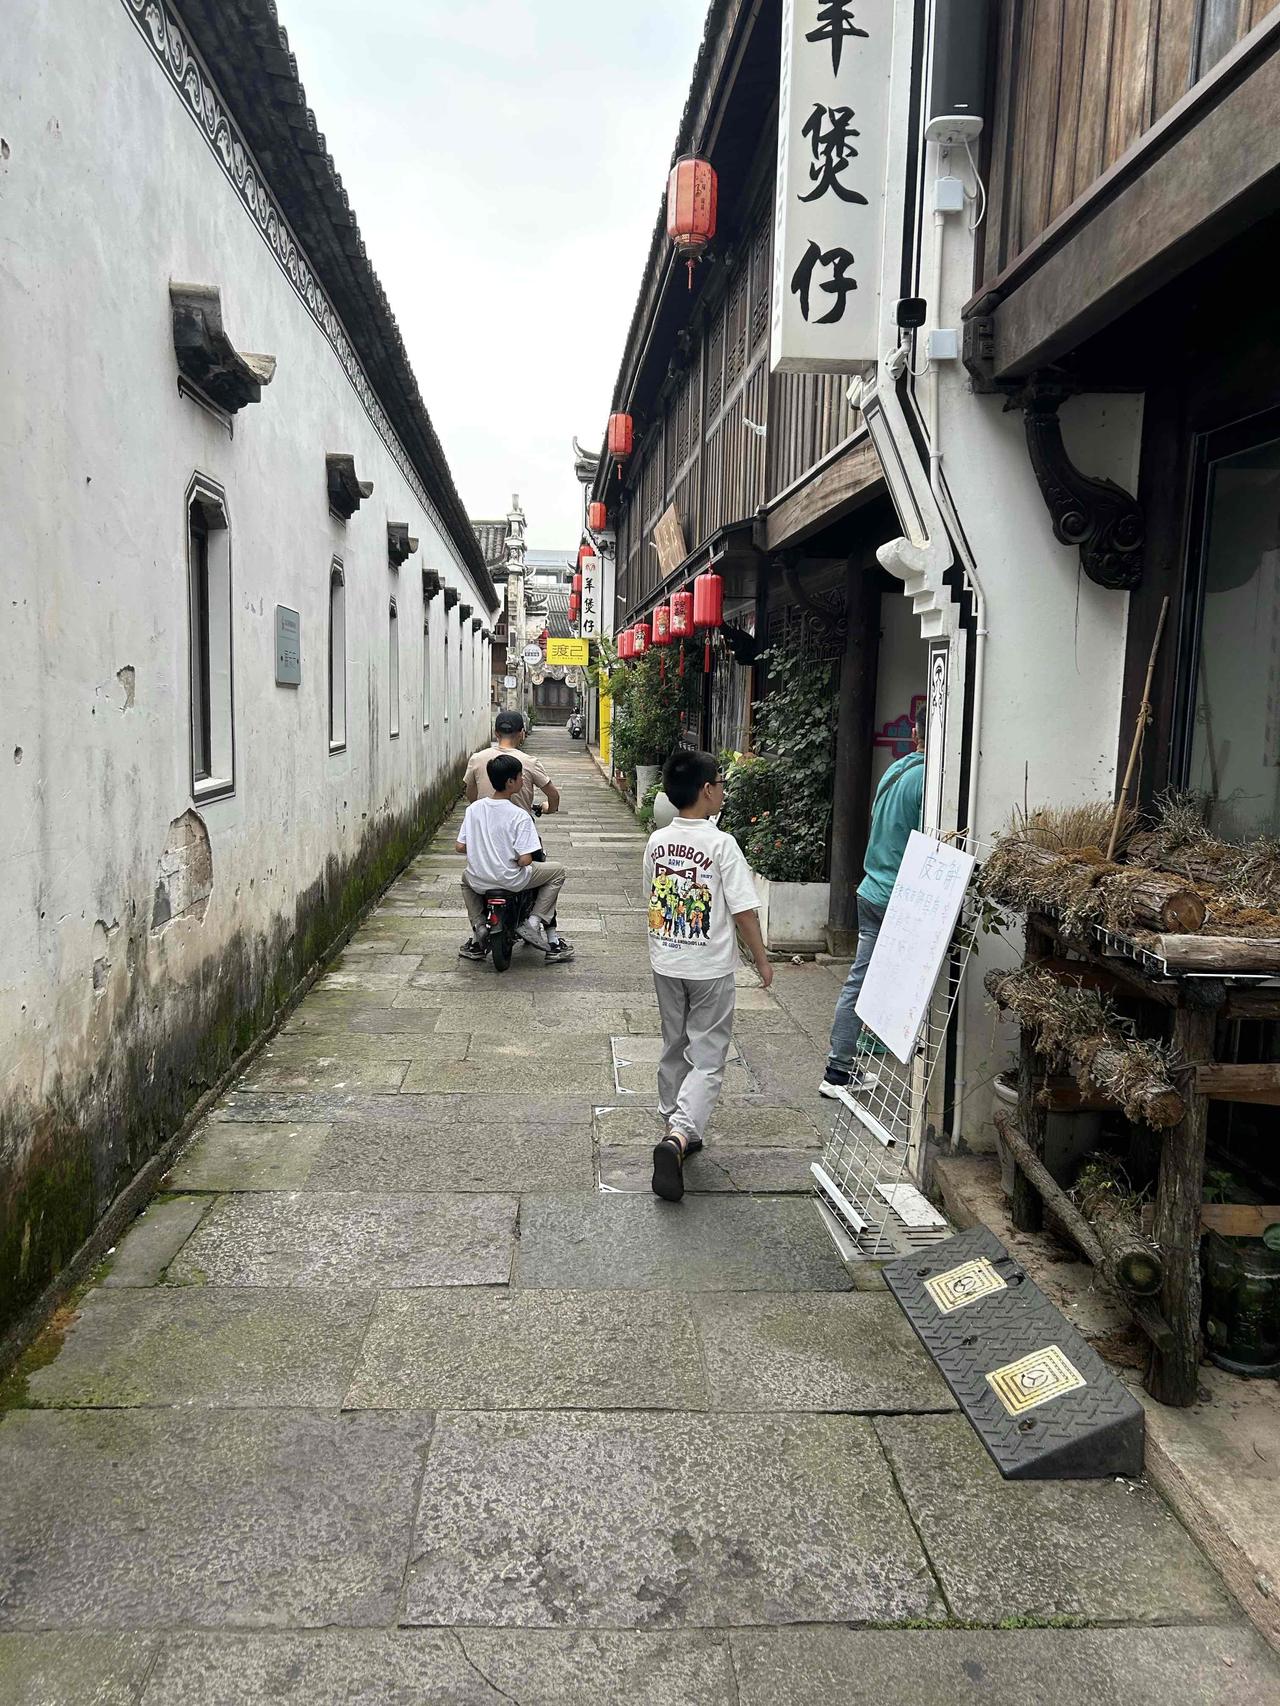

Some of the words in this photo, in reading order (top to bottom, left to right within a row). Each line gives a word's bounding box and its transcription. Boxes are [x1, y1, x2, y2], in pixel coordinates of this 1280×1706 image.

[583, 577, 596, 633] 羊煲仔
[667, 843, 713, 871] RIBBON
[668, 858, 685, 867] ARMY
